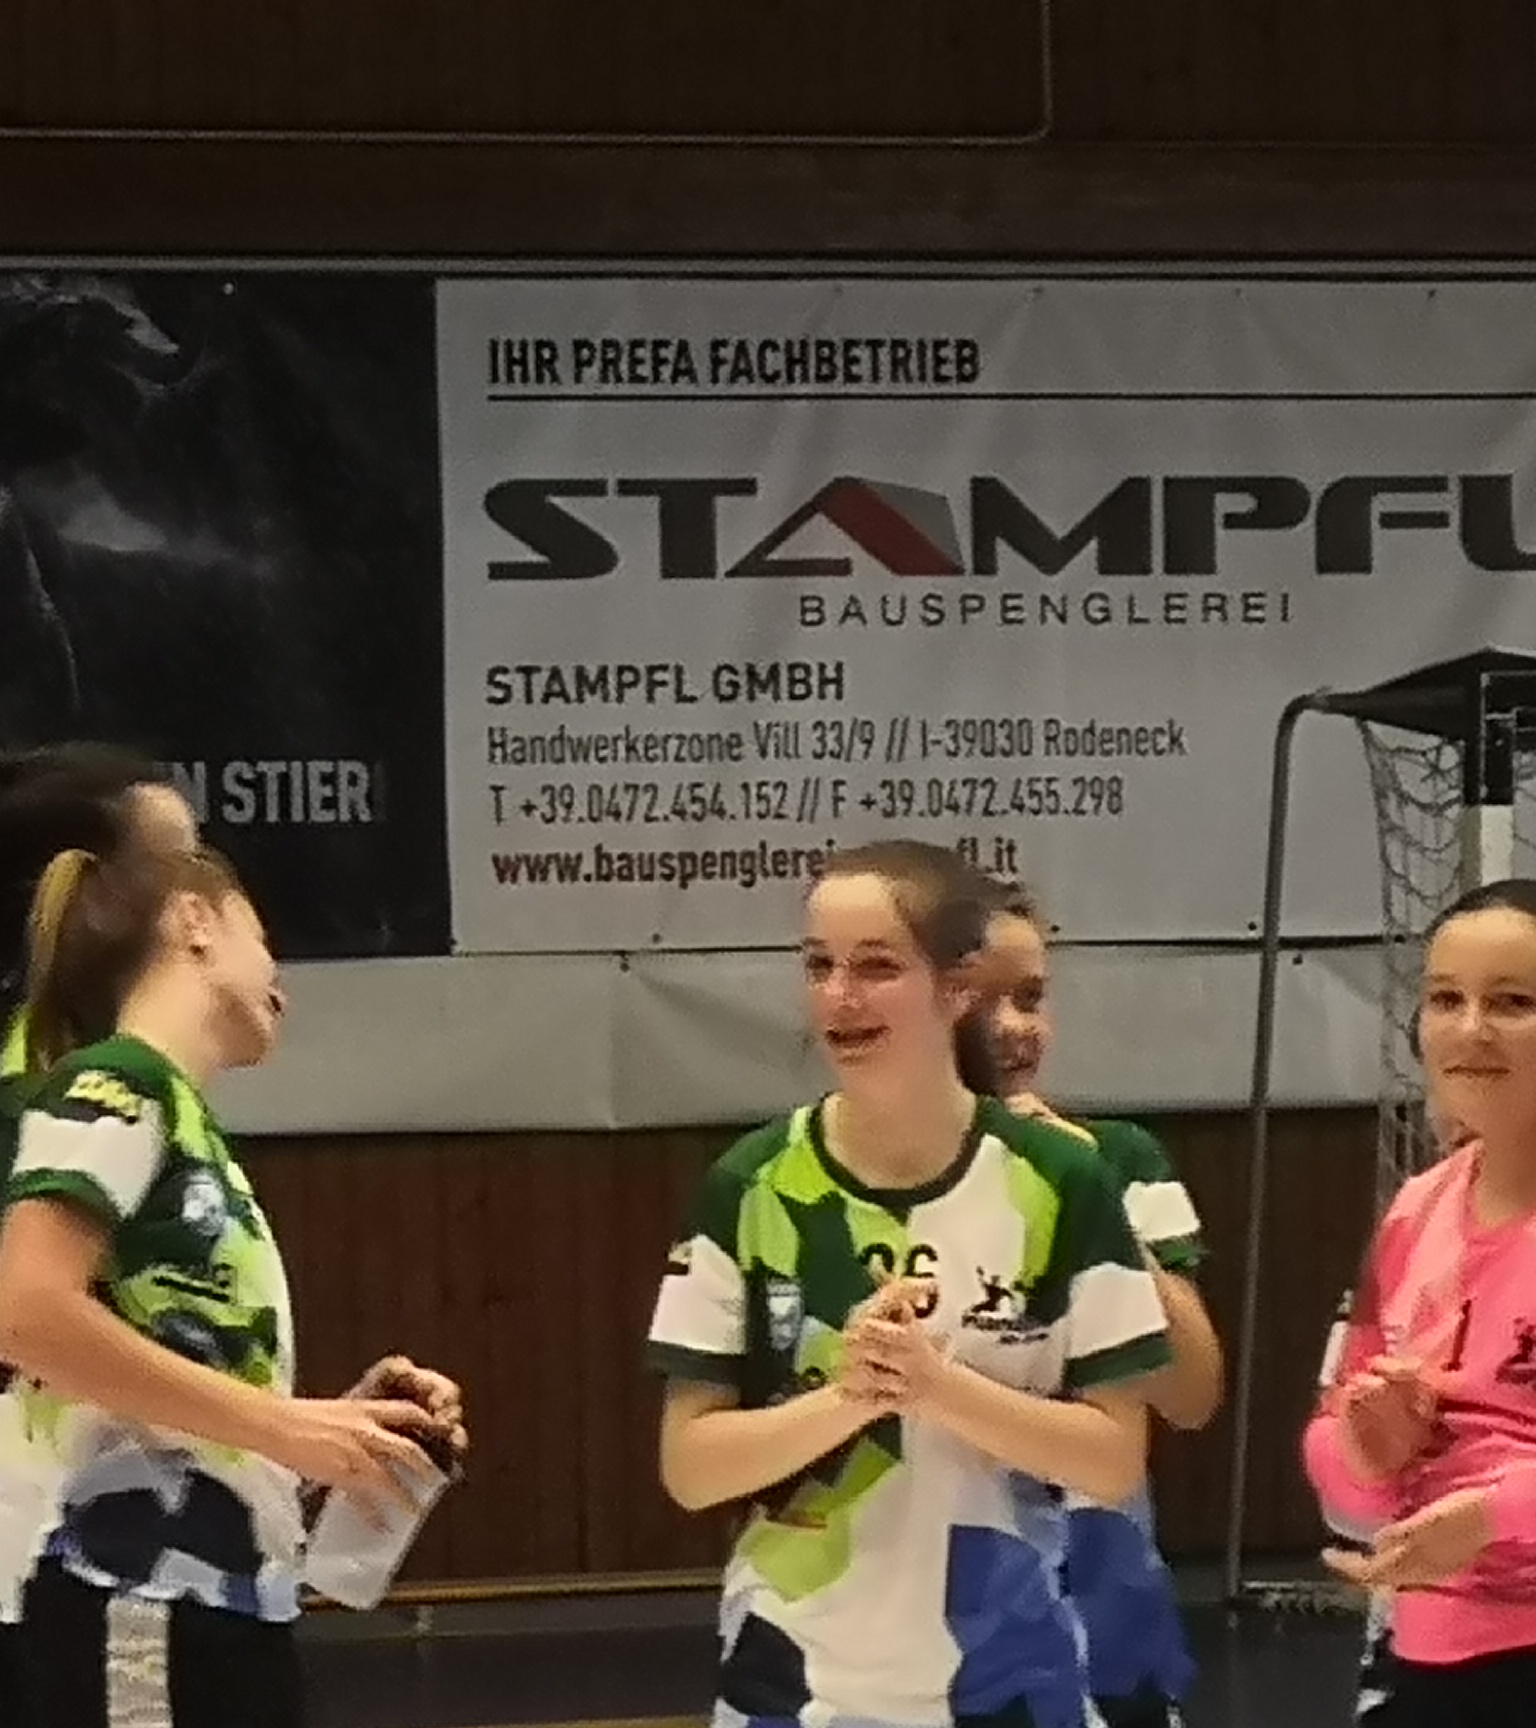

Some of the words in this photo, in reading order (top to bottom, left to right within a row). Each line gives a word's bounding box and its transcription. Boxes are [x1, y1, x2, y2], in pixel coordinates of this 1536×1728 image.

[487, 337, 562, 385] IHR
[572, 337, 700, 385] PREFA
[710, 335, 980, 385] FACHBETRIEB
[799, 592, 1293, 628] BAUSPENGLEREI
[485, 664, 699, 705] STAMPFL
[711, 661, 846, 702] GMBH
[486, 725, 744, 766] Handwerkerzone
[753, 721, 803, 762] Vill
[810, 719, 876, 764] 33/9
[1042, 714, 1188, 758] Rodeneck
[222, 760, 372, 824] STIER
[490, 785, 507, 825] T
[520, 781, 789, 824] +39.0472.454.152
[832, 779, 848, 819] F
[860, 775, 1125, 820] +39.0472.455.298
